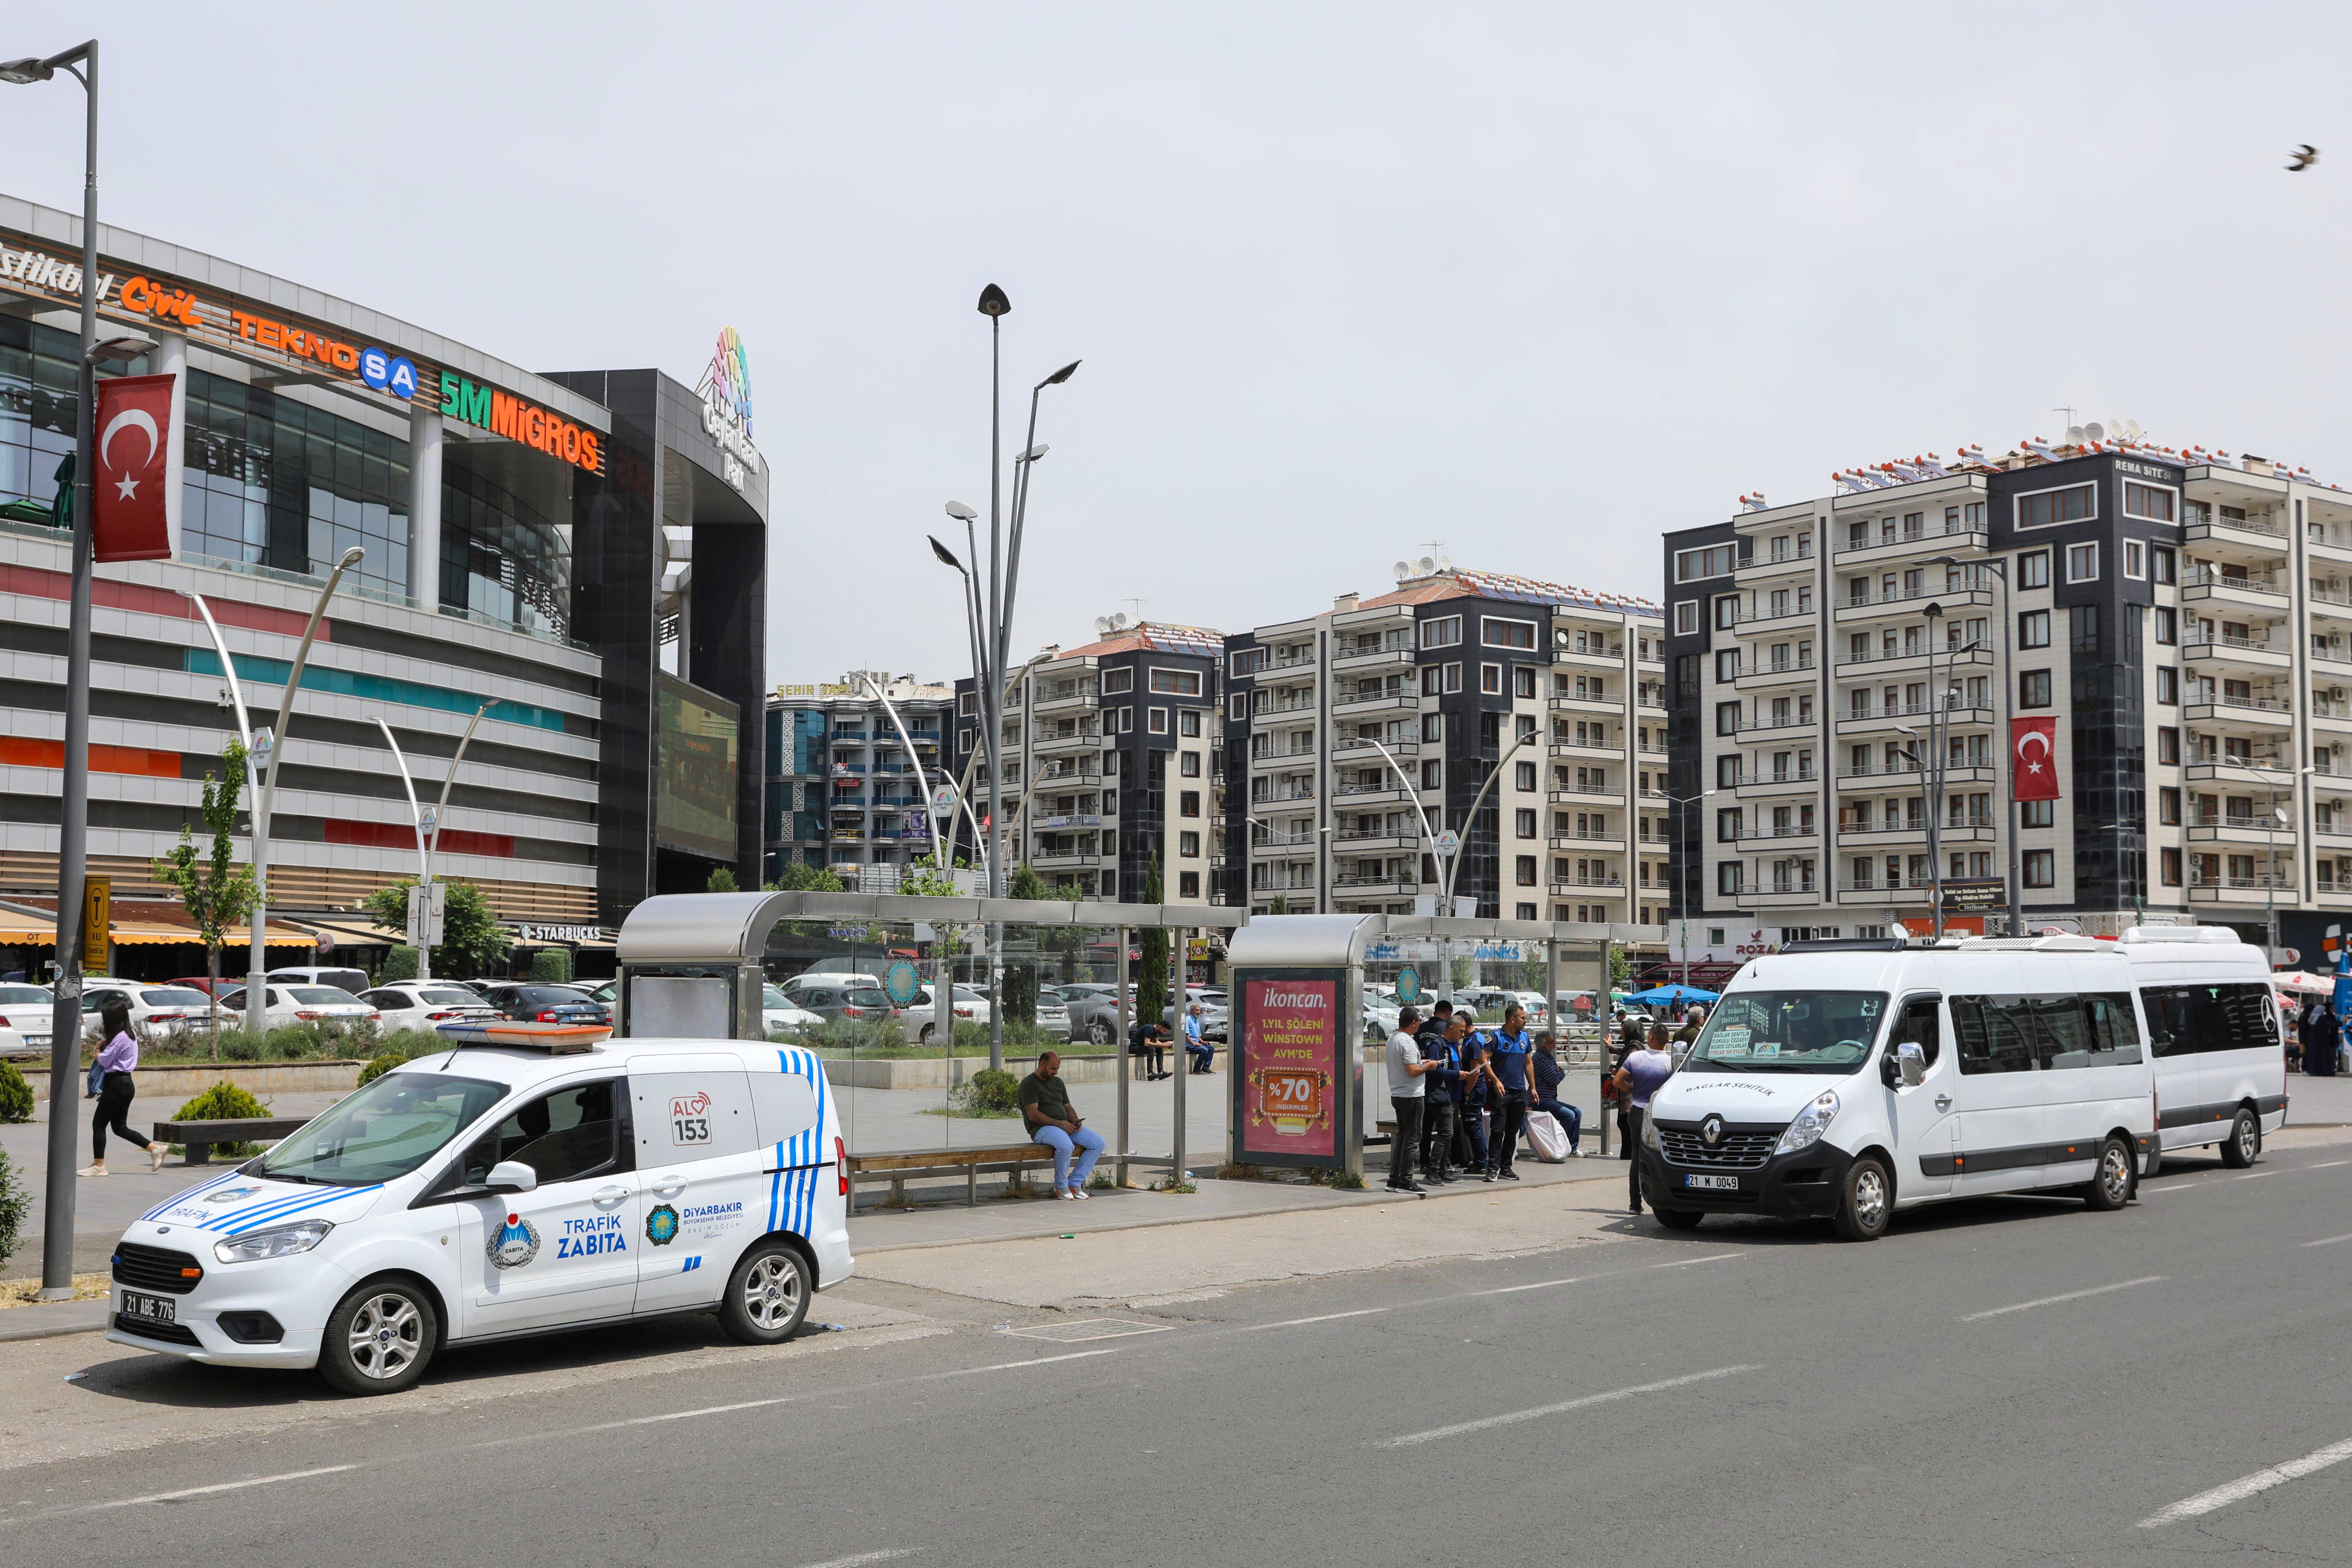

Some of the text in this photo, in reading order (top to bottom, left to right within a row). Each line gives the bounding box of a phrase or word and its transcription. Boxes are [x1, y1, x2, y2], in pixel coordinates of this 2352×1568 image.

[0, 242, 114, 300] stikbl
[232, 311, 358, 371] TEKNO
[441, 370, 491, 429] 5M
[2115, 460, 2140, 474] REMA
[536, 926, 600, 940] STARBUCKS
[828, 928, 867, 938] MADO
[1736, 945, 1776, 954] ROZA
[675, 1119, 708, 1141] 153
[1690, 1176, 1698, 1186] 21
[1705, 1177, 1710, 1187] M
[1716, 1177, 1736, 1188] 0049
[169, 1210, 214, 1221] TRAFİK
[564, 1213, 621, 1234] TRAFİK
[557, 1233, 627, 1259] ZABITA
[127, 1295, 173, 1320] 21 ABE 776
